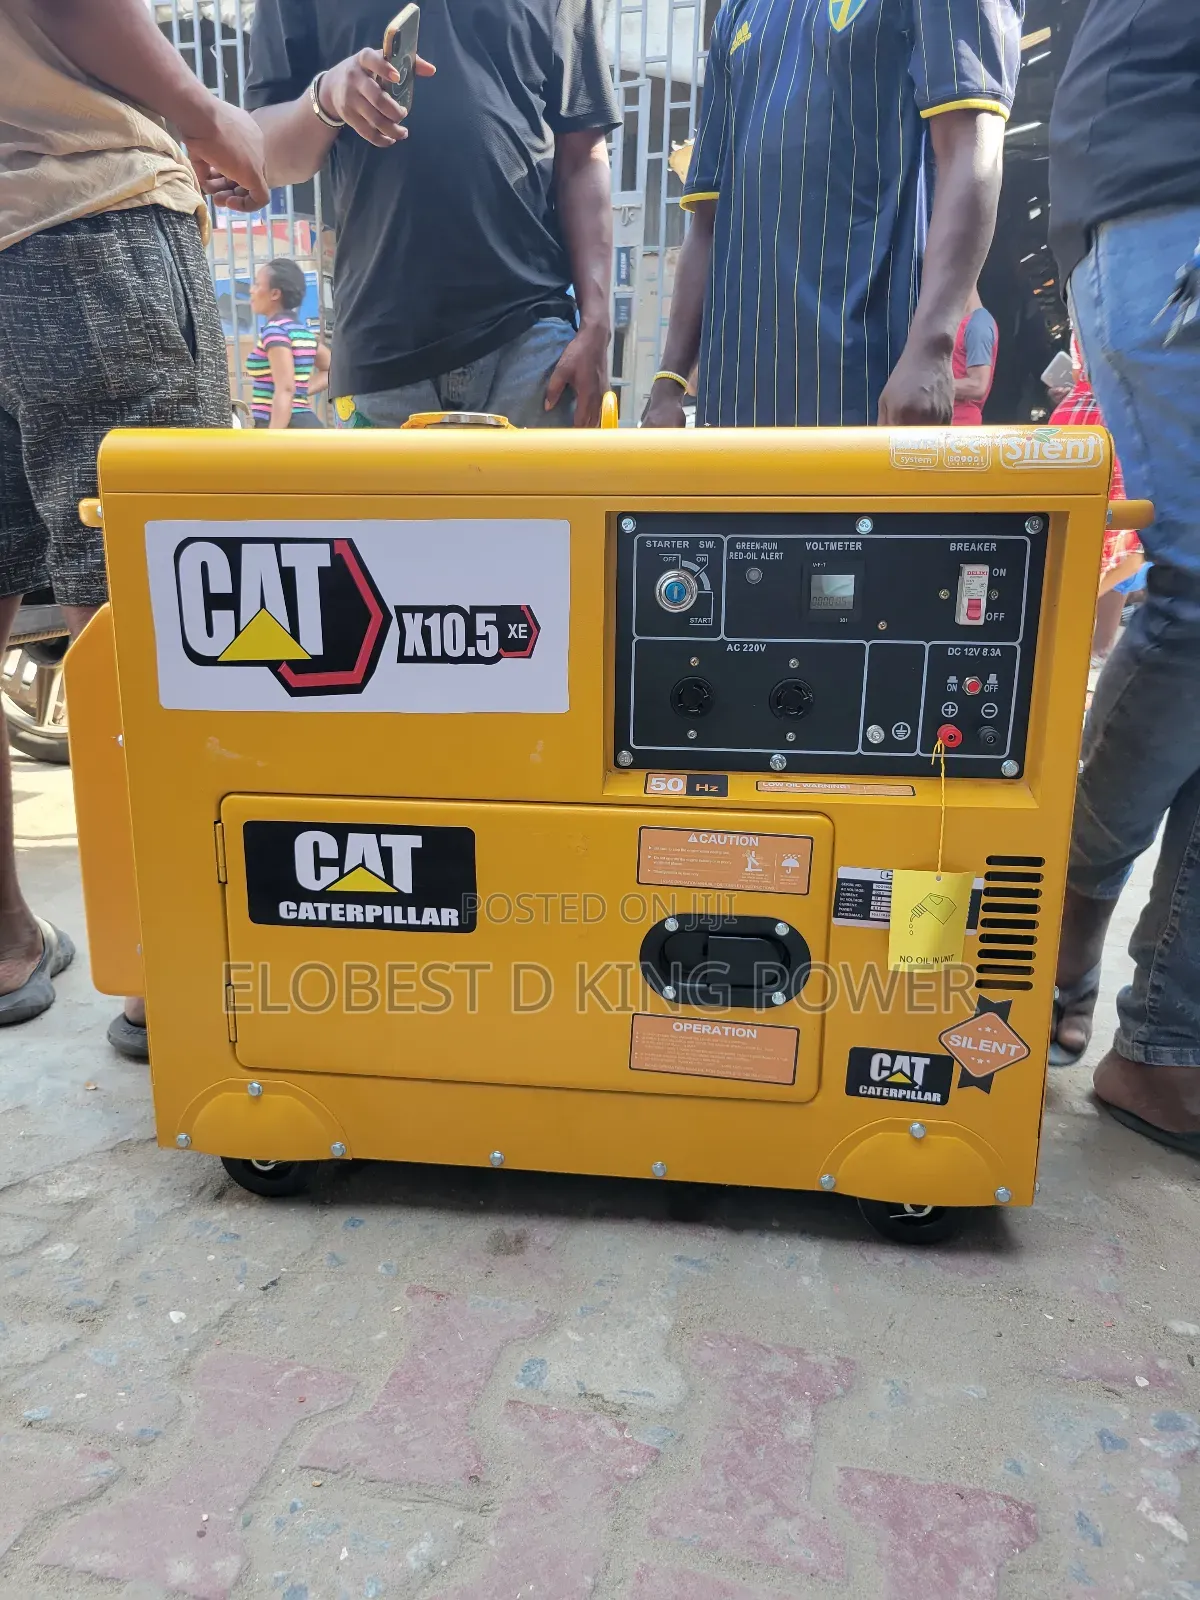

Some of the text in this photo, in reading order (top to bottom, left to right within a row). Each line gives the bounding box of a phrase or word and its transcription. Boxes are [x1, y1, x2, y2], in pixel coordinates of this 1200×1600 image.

[1005, 435, 1096, 461] Silent
[900, 456, 932, 465] system
[645, 540, 717, 549] STARTER SW.
[735, 541, 778, 551] GREEN-RUN
[805, 541, 863, 551] VOLTMETER
[949, 542, 997, 552] BREAKER
[729, 551, 784, 561] RED-OIL ALERT
[992, 567, 1007, 577] ON
[178, 540, 331, 659] CAT
[985, 612, 1006, 622] OFF
[402, 611, 528, 658] X10.5 XE
[726, 643, 767, 653] AC 220V
[947, 647, 1002, 657] DC 12V 8.3A
[946, 683, 958, 692] ON
[984, 684, 999, 693] OFF
[650, 777, 719, 793] 50 Hz
[699, 833, 760, 847] CAUTION
[294, 830, 423, 894] CAT
[278, 900, 459, 927] CATERPILLAR
[899, 953, 955, 965] NO OIL IN UNIT
[672, 1021, 757, 1039] OPERATION
[948, 1034, 1021, 1058] SILENT
[869, 1052, 931, 1088] CAT
[858, 1084, 942, 1104] CATERPILLAR
